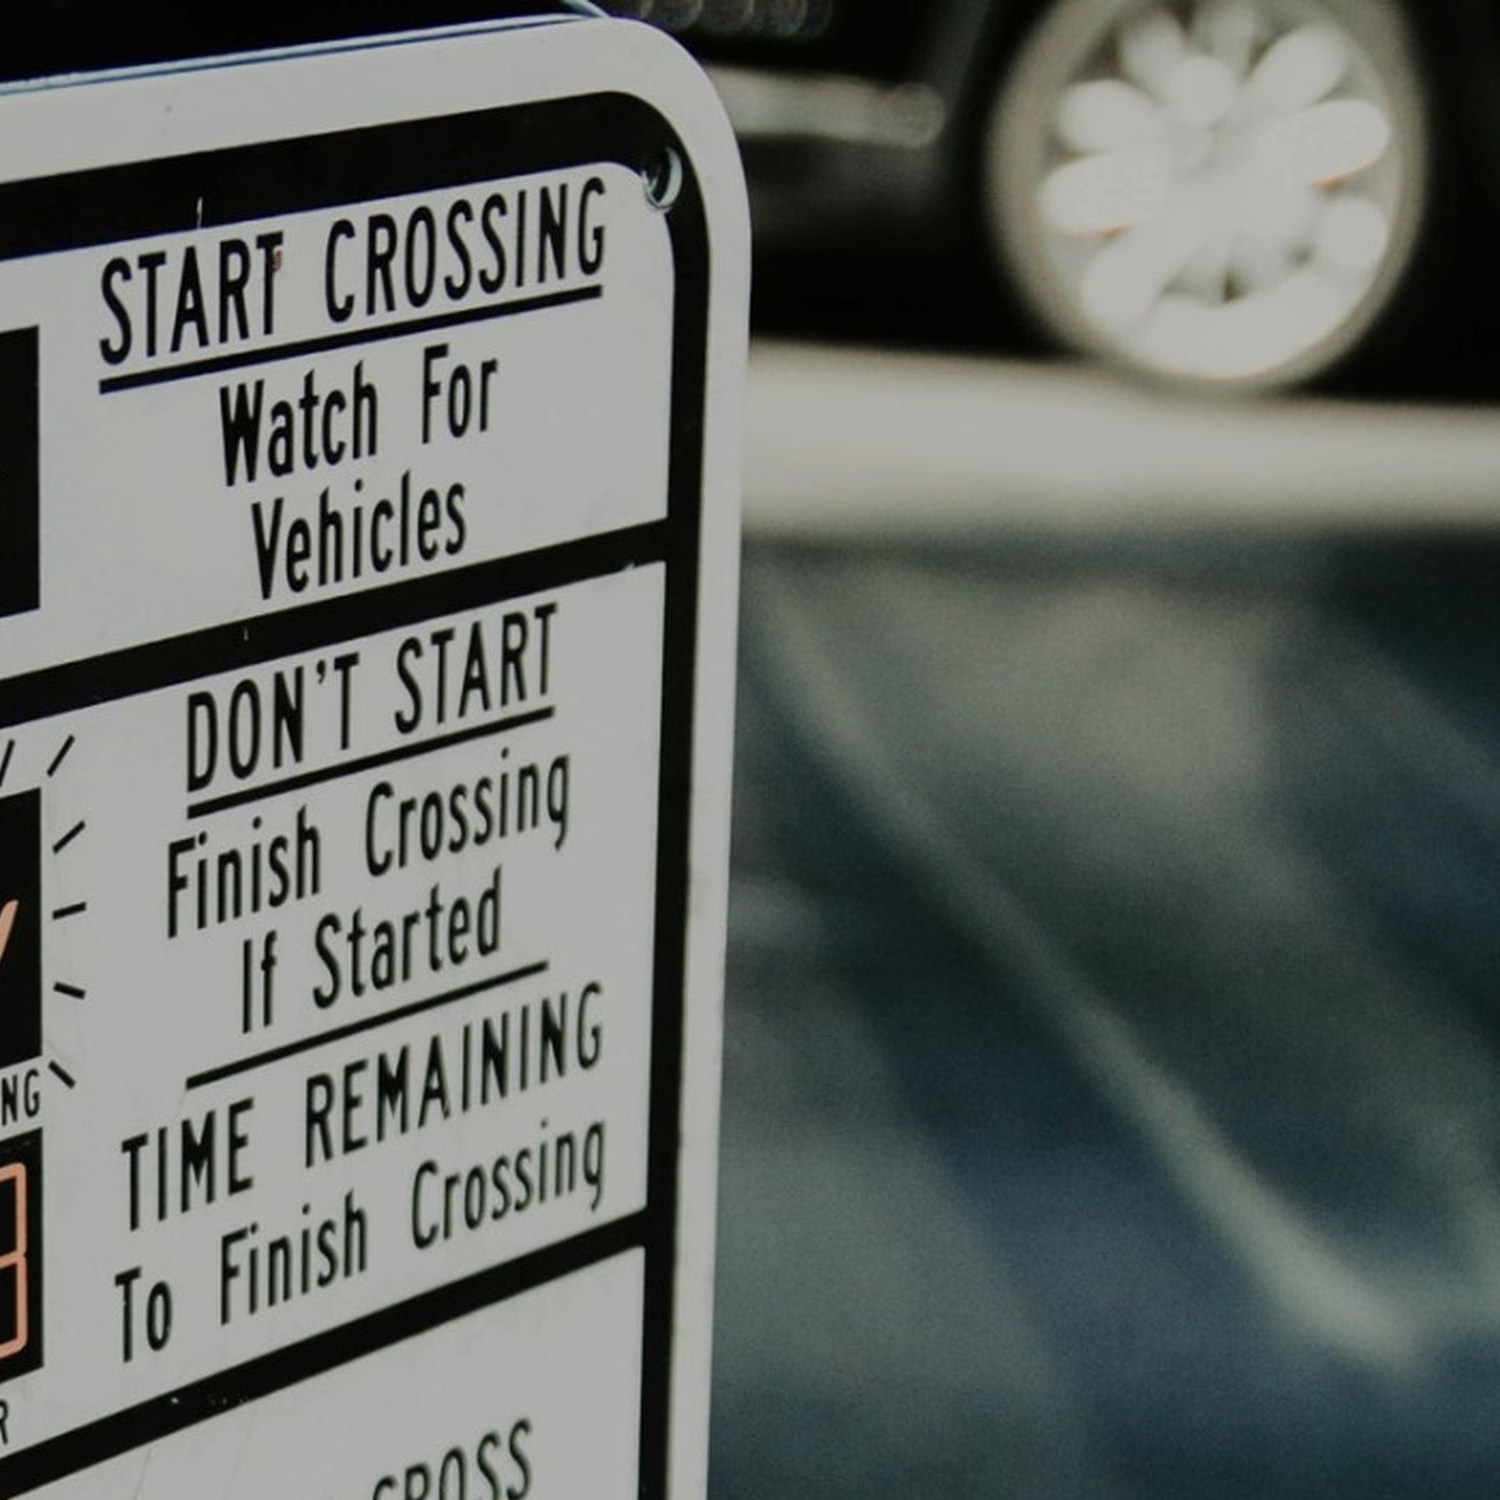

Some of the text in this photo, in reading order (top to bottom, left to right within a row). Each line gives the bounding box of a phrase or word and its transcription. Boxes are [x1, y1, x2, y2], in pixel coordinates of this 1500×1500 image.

[99, 177, 606, 366] START CROSSING
[219, 343, 498, 487] Watch For
[251, 470, 466, 601] Vehicles
[187, 602, 557, 793] DON'T START
[167, 748, 569, 939] Finish Crossing
[242, 867, 501, 1034] If Started
[121, 982, 601, 1232] TIME REMAINING
[114, 1119, 604, 1363] To Finish Crossing
